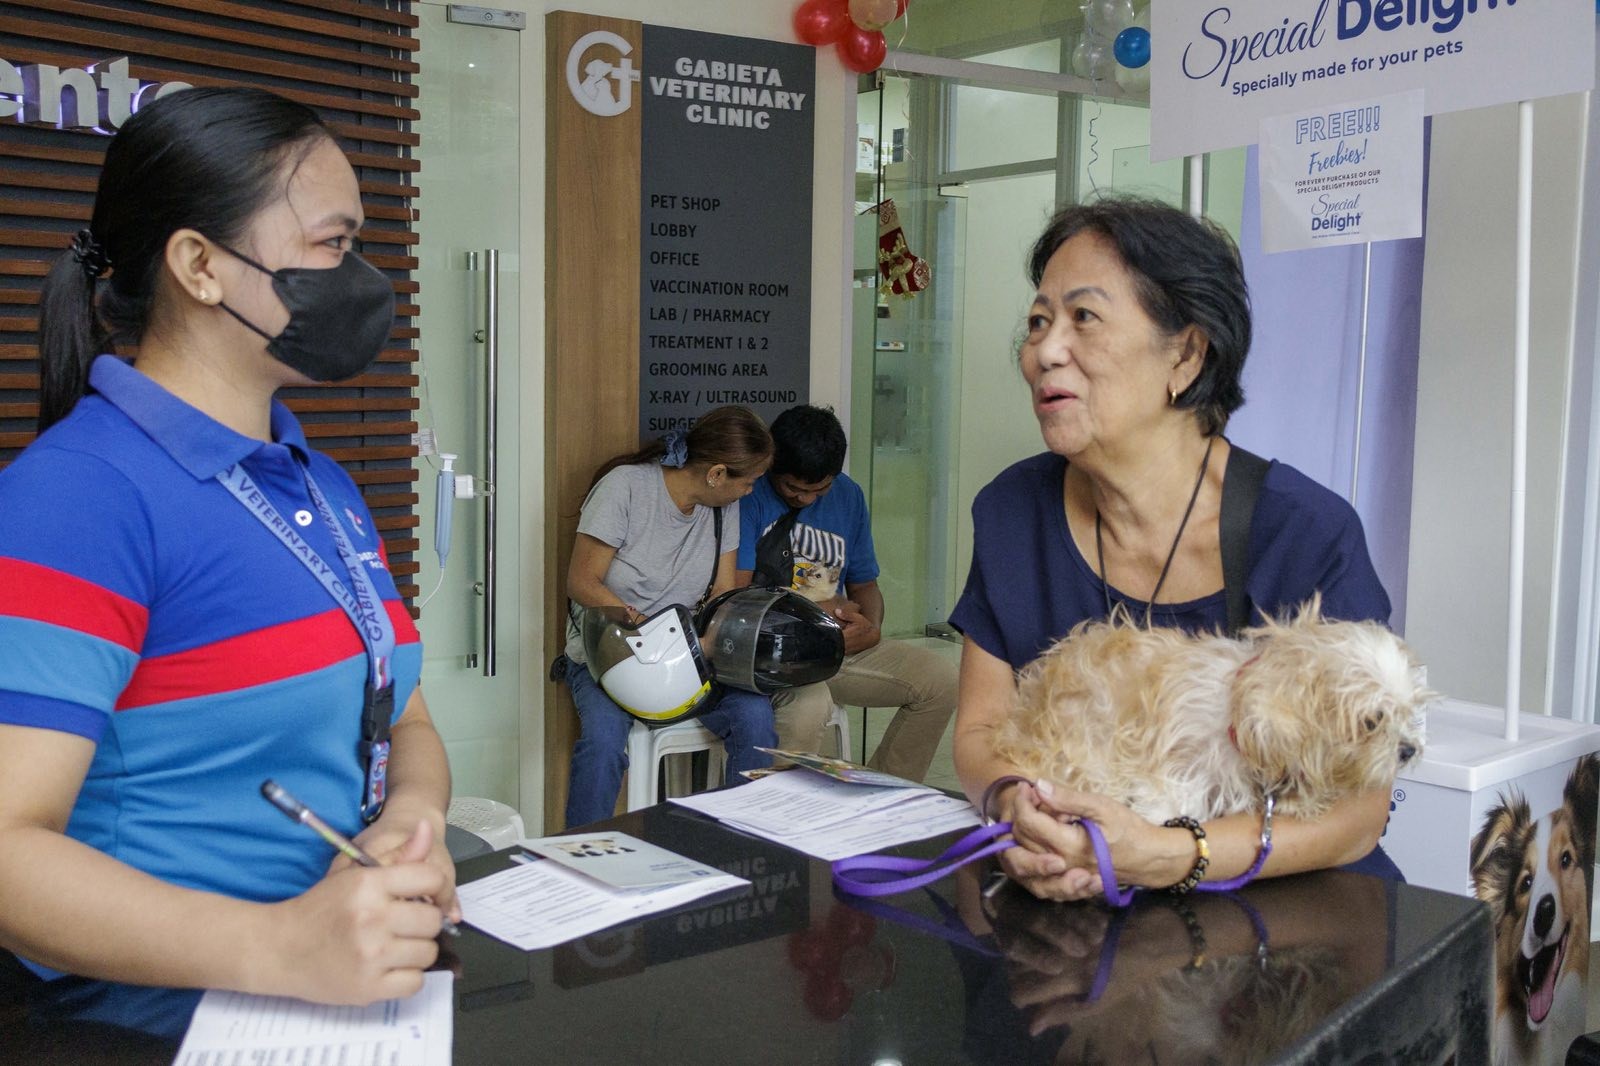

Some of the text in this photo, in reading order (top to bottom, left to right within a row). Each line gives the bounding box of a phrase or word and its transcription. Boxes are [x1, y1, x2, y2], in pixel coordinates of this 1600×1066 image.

[1182, 0, 1516, 87] Special Delig
[675, 57, 782, 87] GABIETA
[1232, 40, 1463, 96] Specially made for your pets
[650, 76, 806, 111] VETERINARY
[686, 104, 770, 130] CLINIC
[1295, 105, 1380, 144] FREE!!!
[1308, 138, 1368, 175] Freebies!
[1297, 178, 1379, 194] SPECIAL DELIGHT PRODUCTS
[1307, 178, 1325, 186] EVERY
[1326, 172, 1358, 182] PURCHASE
[650, 194, 720, 212] PET SHOP
[1311, 193, 1361, 218] Special
[650, 222, 697, 238] LOBBY
[1311, 212, 1361, 231] Delight
[649, 251, 700, 266] OFFICE
[650, 279, 789, 297] VACCINATION ROOM
[650, 307, 677, 321] LAB
[693, 308, 771, 323] PHARMACY
[649, 335, 733, 349] TREATMENT
[747, 337, 756, 350] &
[760, 337, 769, 350] 2
[649, 362, 768, 377] GROOMING AREA
[649, 390, 691, 404] X-RAY
[706, 390, 797, 404] ULTRASOUND
[649, 417, 697, 431] SURGE
[239, 478, 331, 576] VETERINARY
[350, 565, 383, 642] GABIETA
